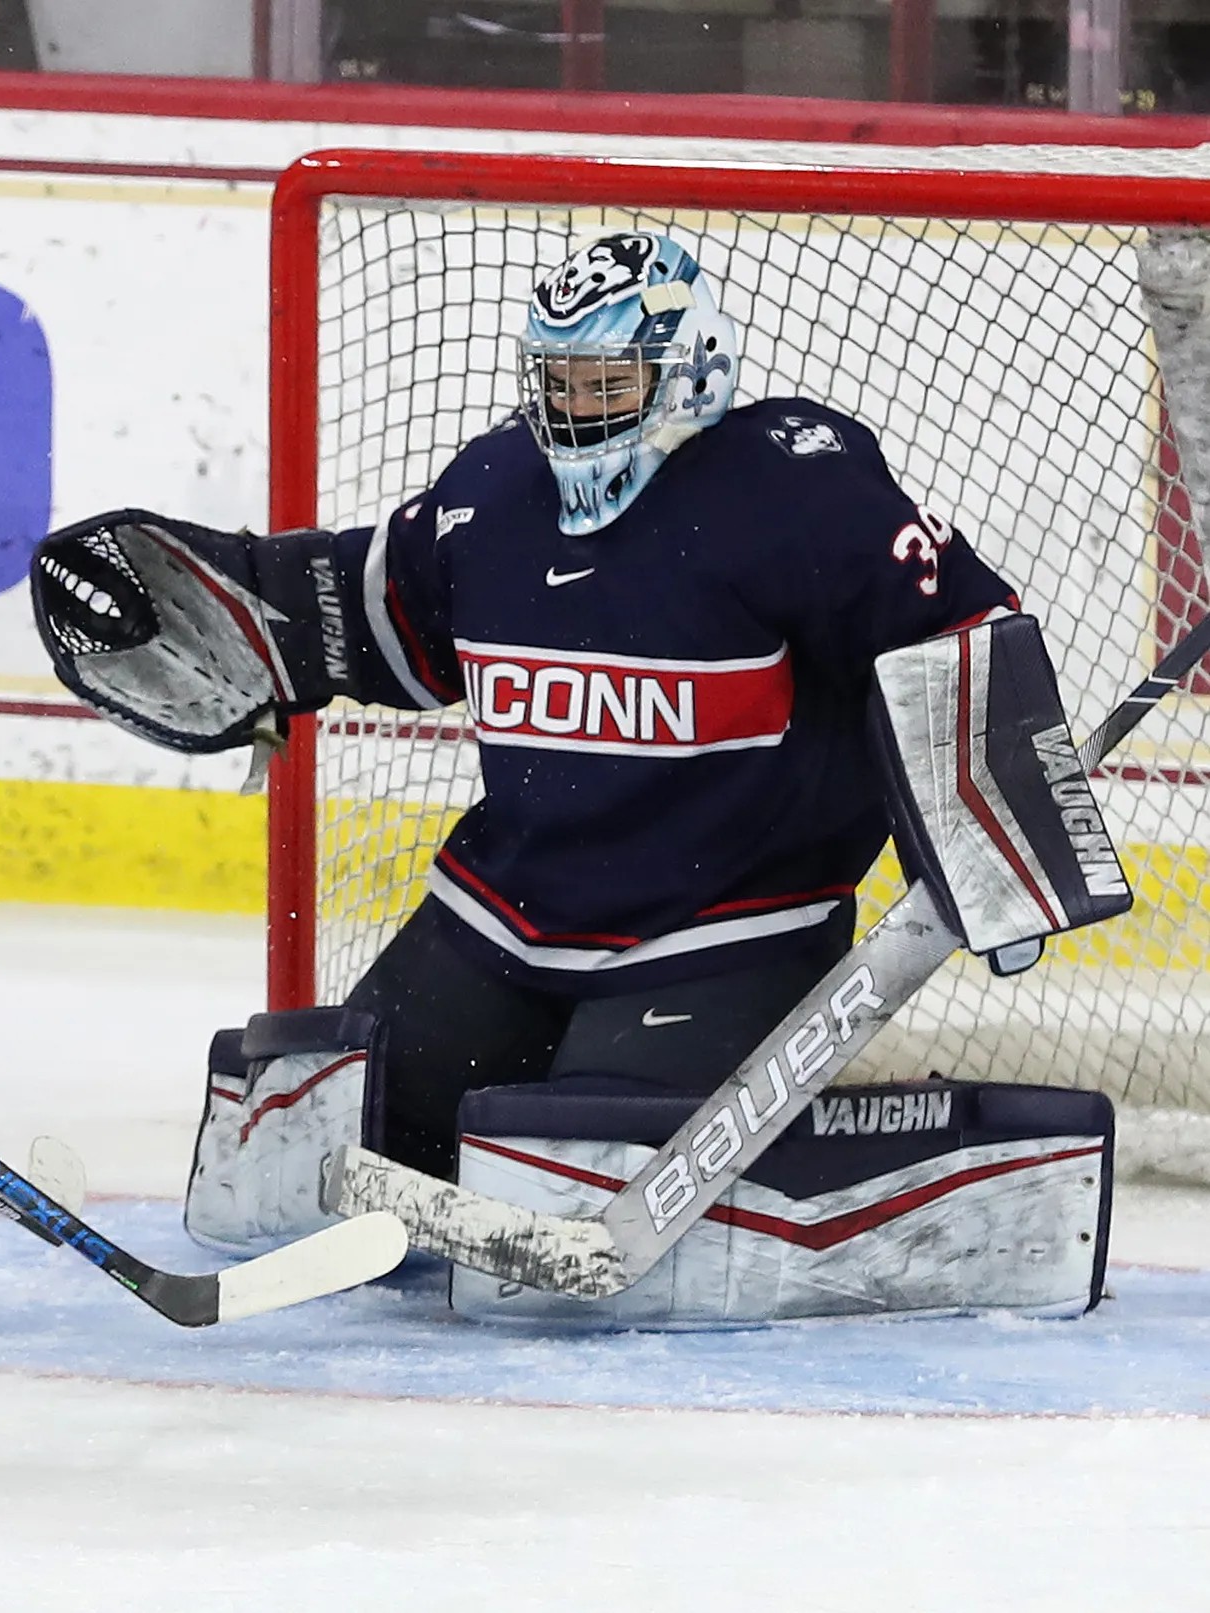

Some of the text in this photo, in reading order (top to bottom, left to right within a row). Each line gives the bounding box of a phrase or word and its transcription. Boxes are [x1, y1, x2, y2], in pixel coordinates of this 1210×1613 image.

[310, 558, 349, 680] VAUGHN
[1031, 723, 1129, 896] VAUGHN
[642, 963, 887, 1236] BAUER
[811, 1090, 952, 1136] VAUGHN
